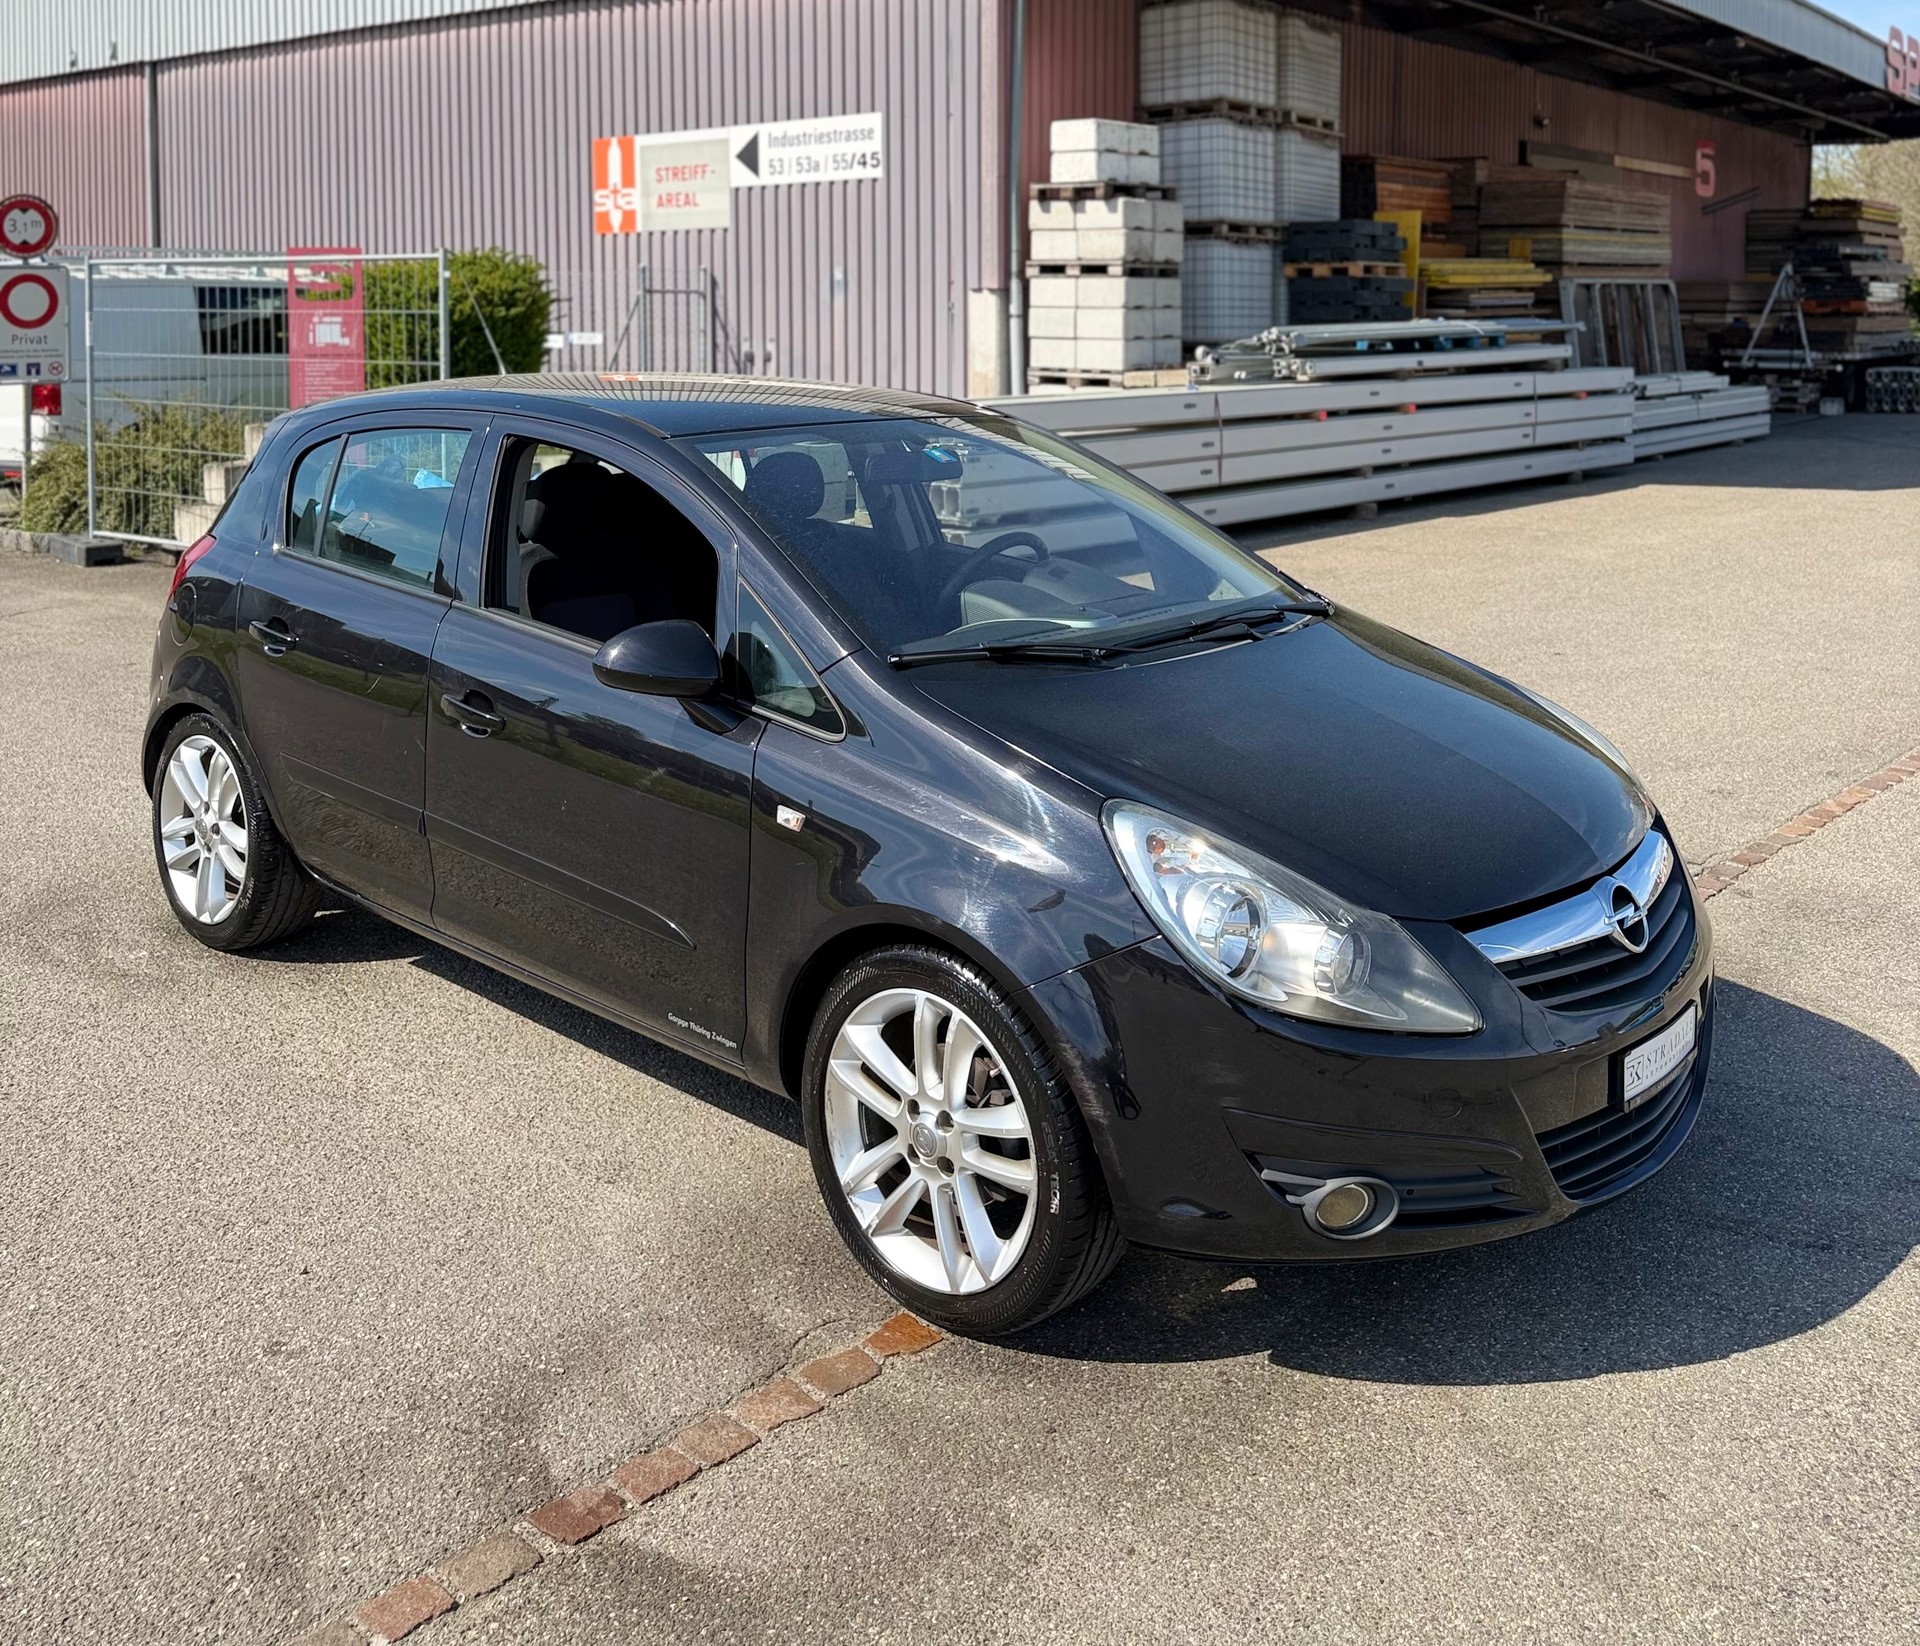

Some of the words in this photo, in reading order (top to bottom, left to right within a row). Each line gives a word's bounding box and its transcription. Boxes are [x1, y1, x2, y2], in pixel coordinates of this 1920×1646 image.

[768, 127, 875, 149] Industriestrasse
[655, 163, 717, 184] STREIFF-
[768, 157, 785, 176] 53
[795, 155, 821, 174] 53a
[1694, 139, 1716, 198] 5
[656, 191, 700, 209] AREAL
[11, 333, 49, 345] Privat
